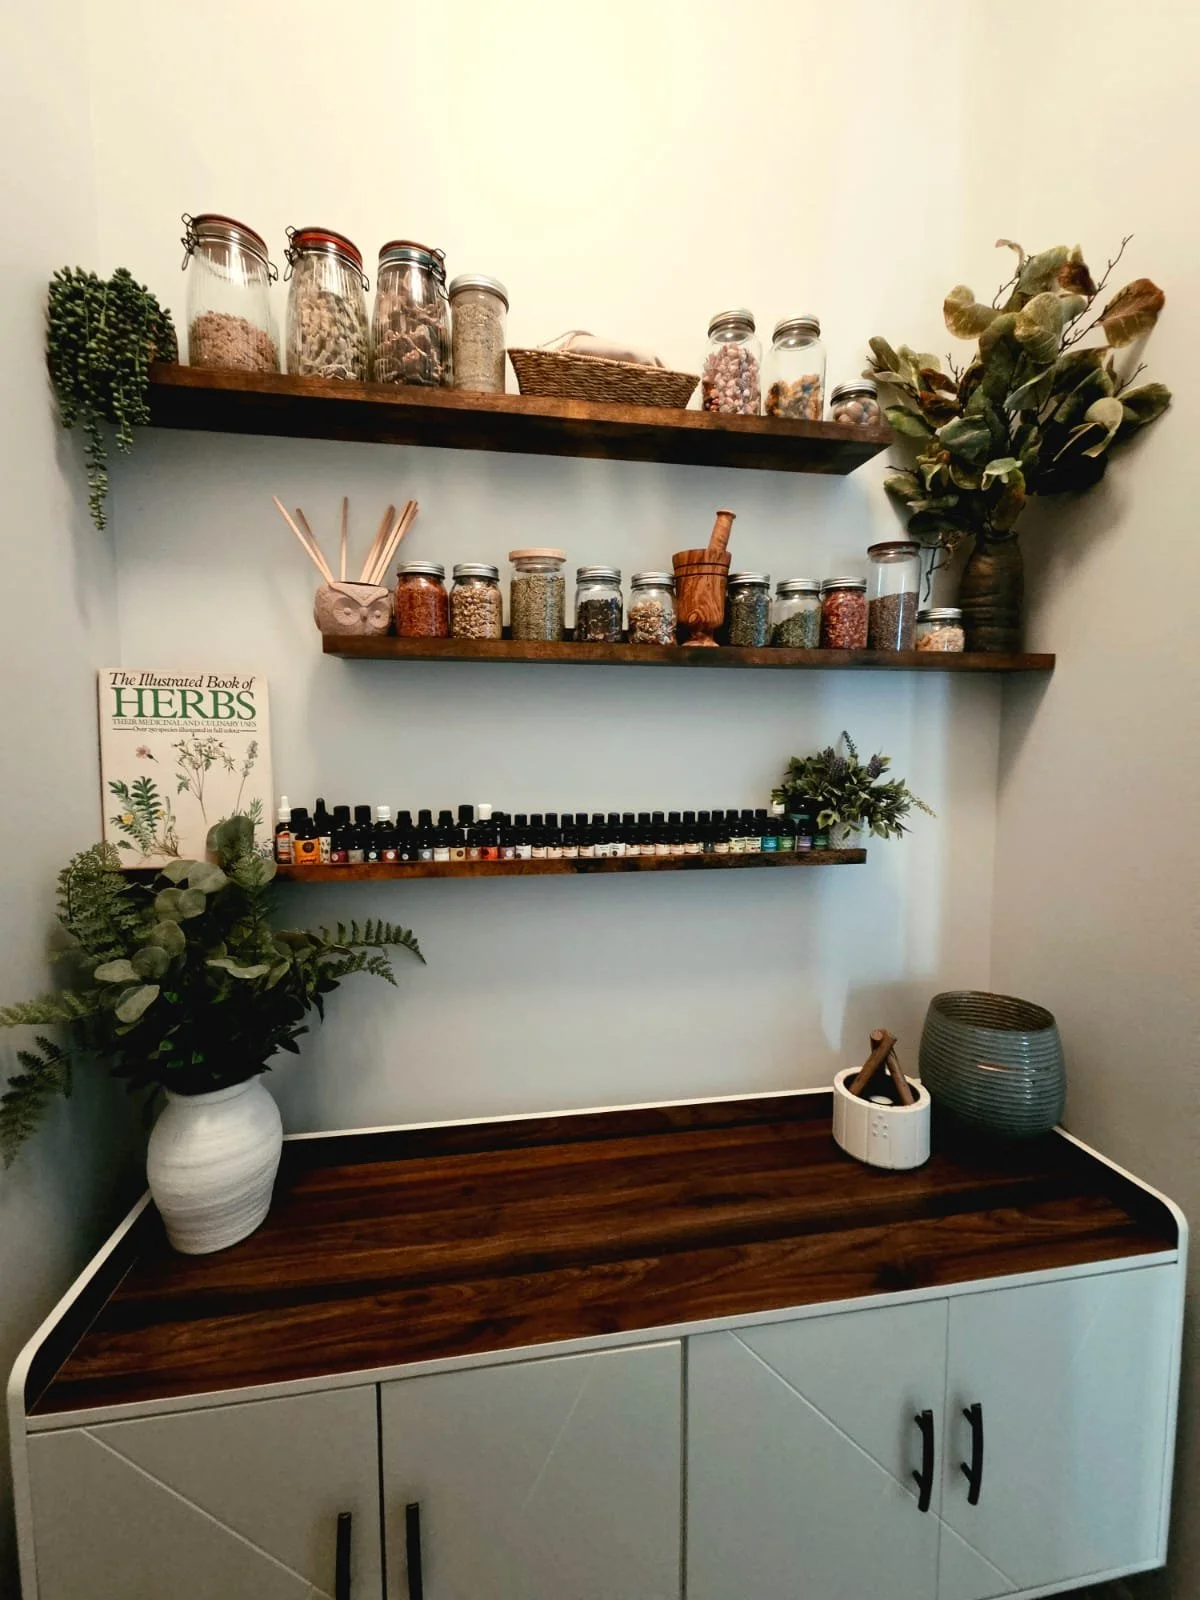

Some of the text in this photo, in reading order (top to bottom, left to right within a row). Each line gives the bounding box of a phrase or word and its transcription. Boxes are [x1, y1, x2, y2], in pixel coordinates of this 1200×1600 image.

[109, 672, 256, 691] The Illustrated Book of
[111, 687, 257, 720] HERBS
